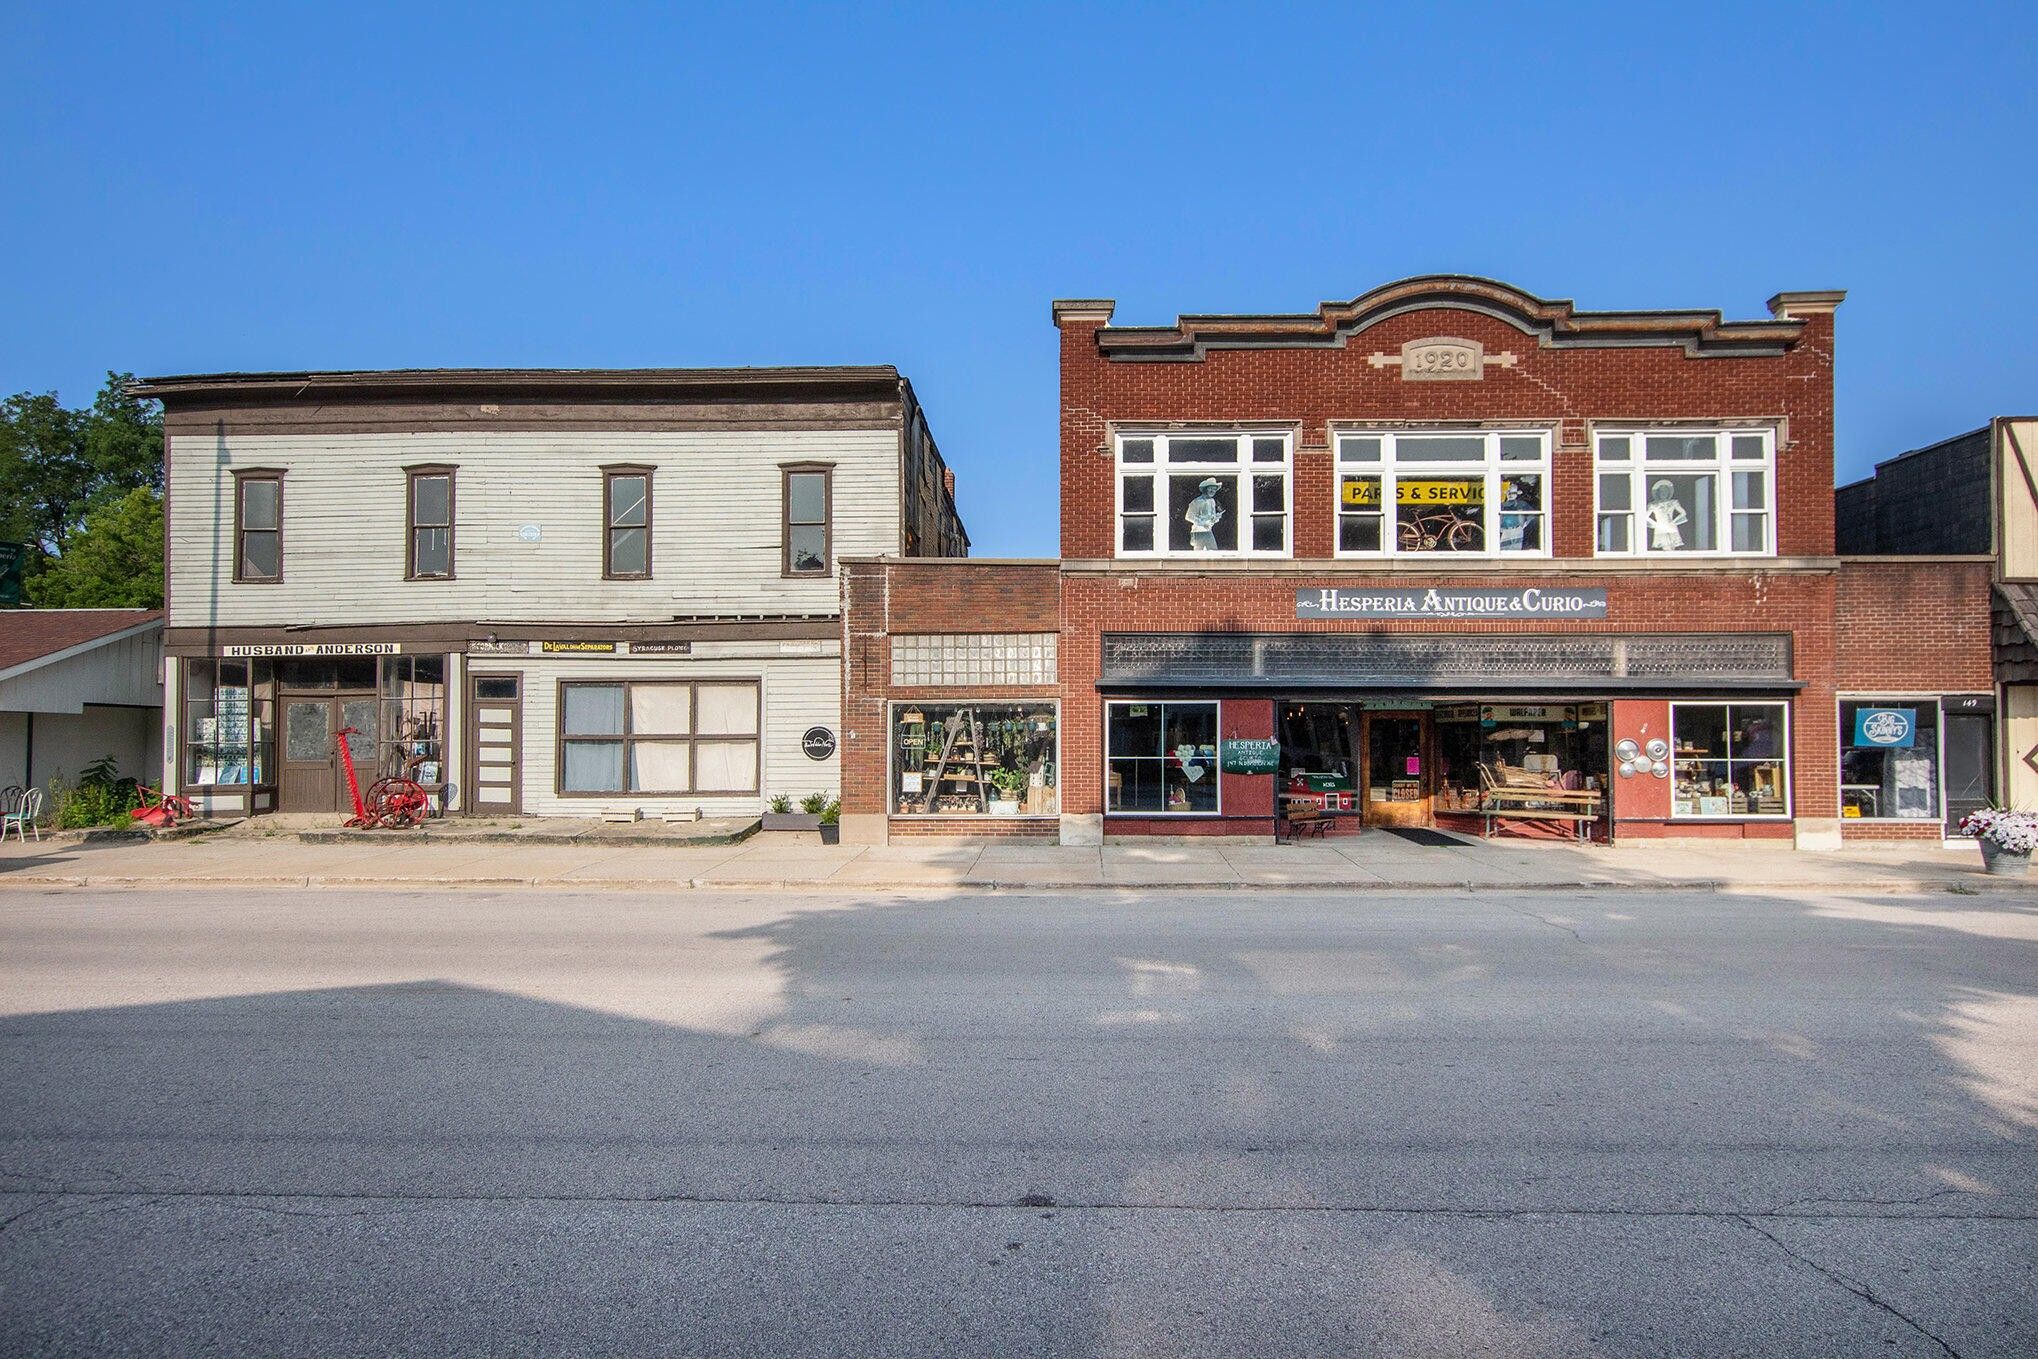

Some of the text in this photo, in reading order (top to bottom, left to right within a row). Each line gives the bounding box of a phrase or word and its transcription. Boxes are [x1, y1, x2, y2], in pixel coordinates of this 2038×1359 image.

[1415, 350, 1469, 372] 1920
[1352, 487, 1485, 499] PARS & SERVIC
[1318, 588, 1584, 612] HESPERIA ANTIQUE & CURIO
[231, 645, 304, 656] HUSBAND
[316, 644, 394, 655] ANDERSON
[903, 738, 924, 746] OPEN
[1228, 741, 1272, 750] HESPERIA
[1392, 788, 1419, 800] CLOSED
